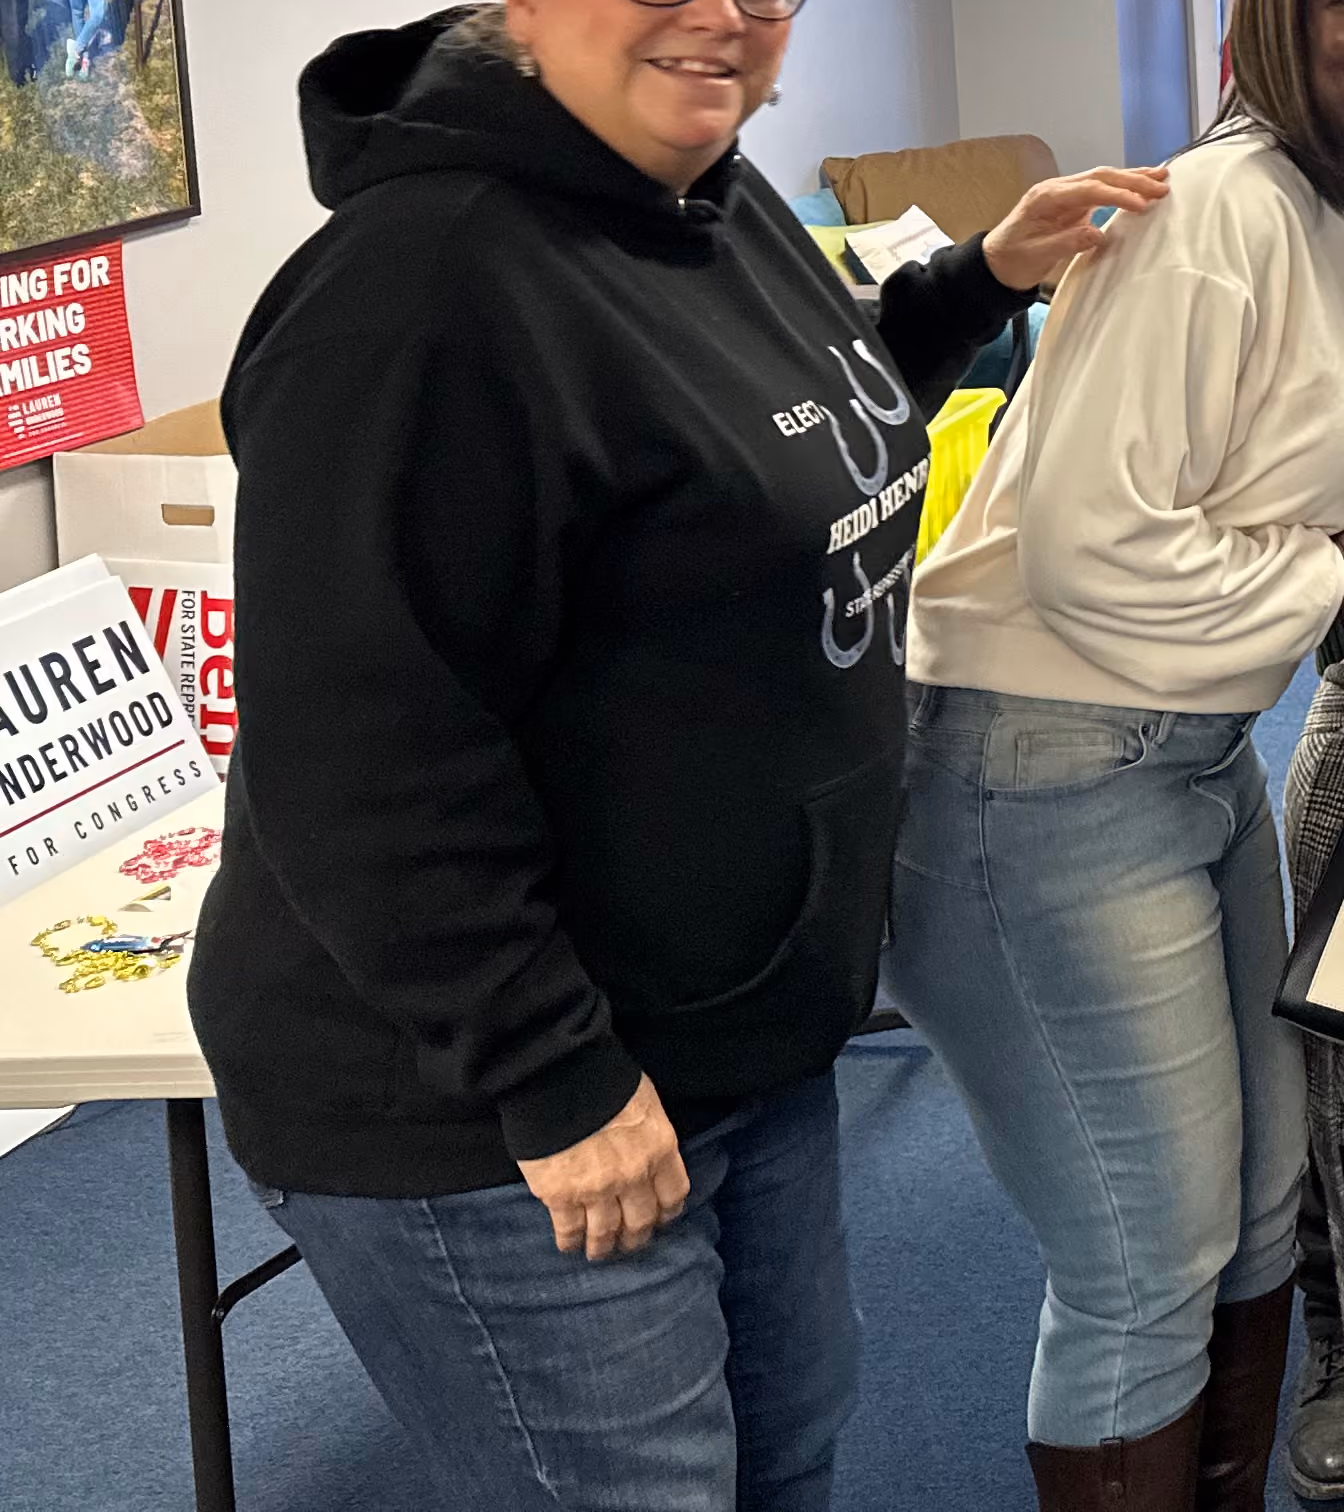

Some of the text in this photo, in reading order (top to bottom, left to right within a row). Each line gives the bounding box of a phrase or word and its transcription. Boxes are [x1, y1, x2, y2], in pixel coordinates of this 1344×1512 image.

[53, 255, 110, 296] FOR
[0, 302, 85, 352] RKING
[0, 343, 92, 397] MILIES
[22, 393, 62, 415] LAUREN
[772, 399, 825, 438] ELECT
[826, 452, 931, 555] HEIDI HENR
[181, 590, 195, 619] FOR
[181, 623, 195, 668] STATE
[200, 590, 239, 756] Ben
[8, 760, 202, 876] FOR CONGRESS
